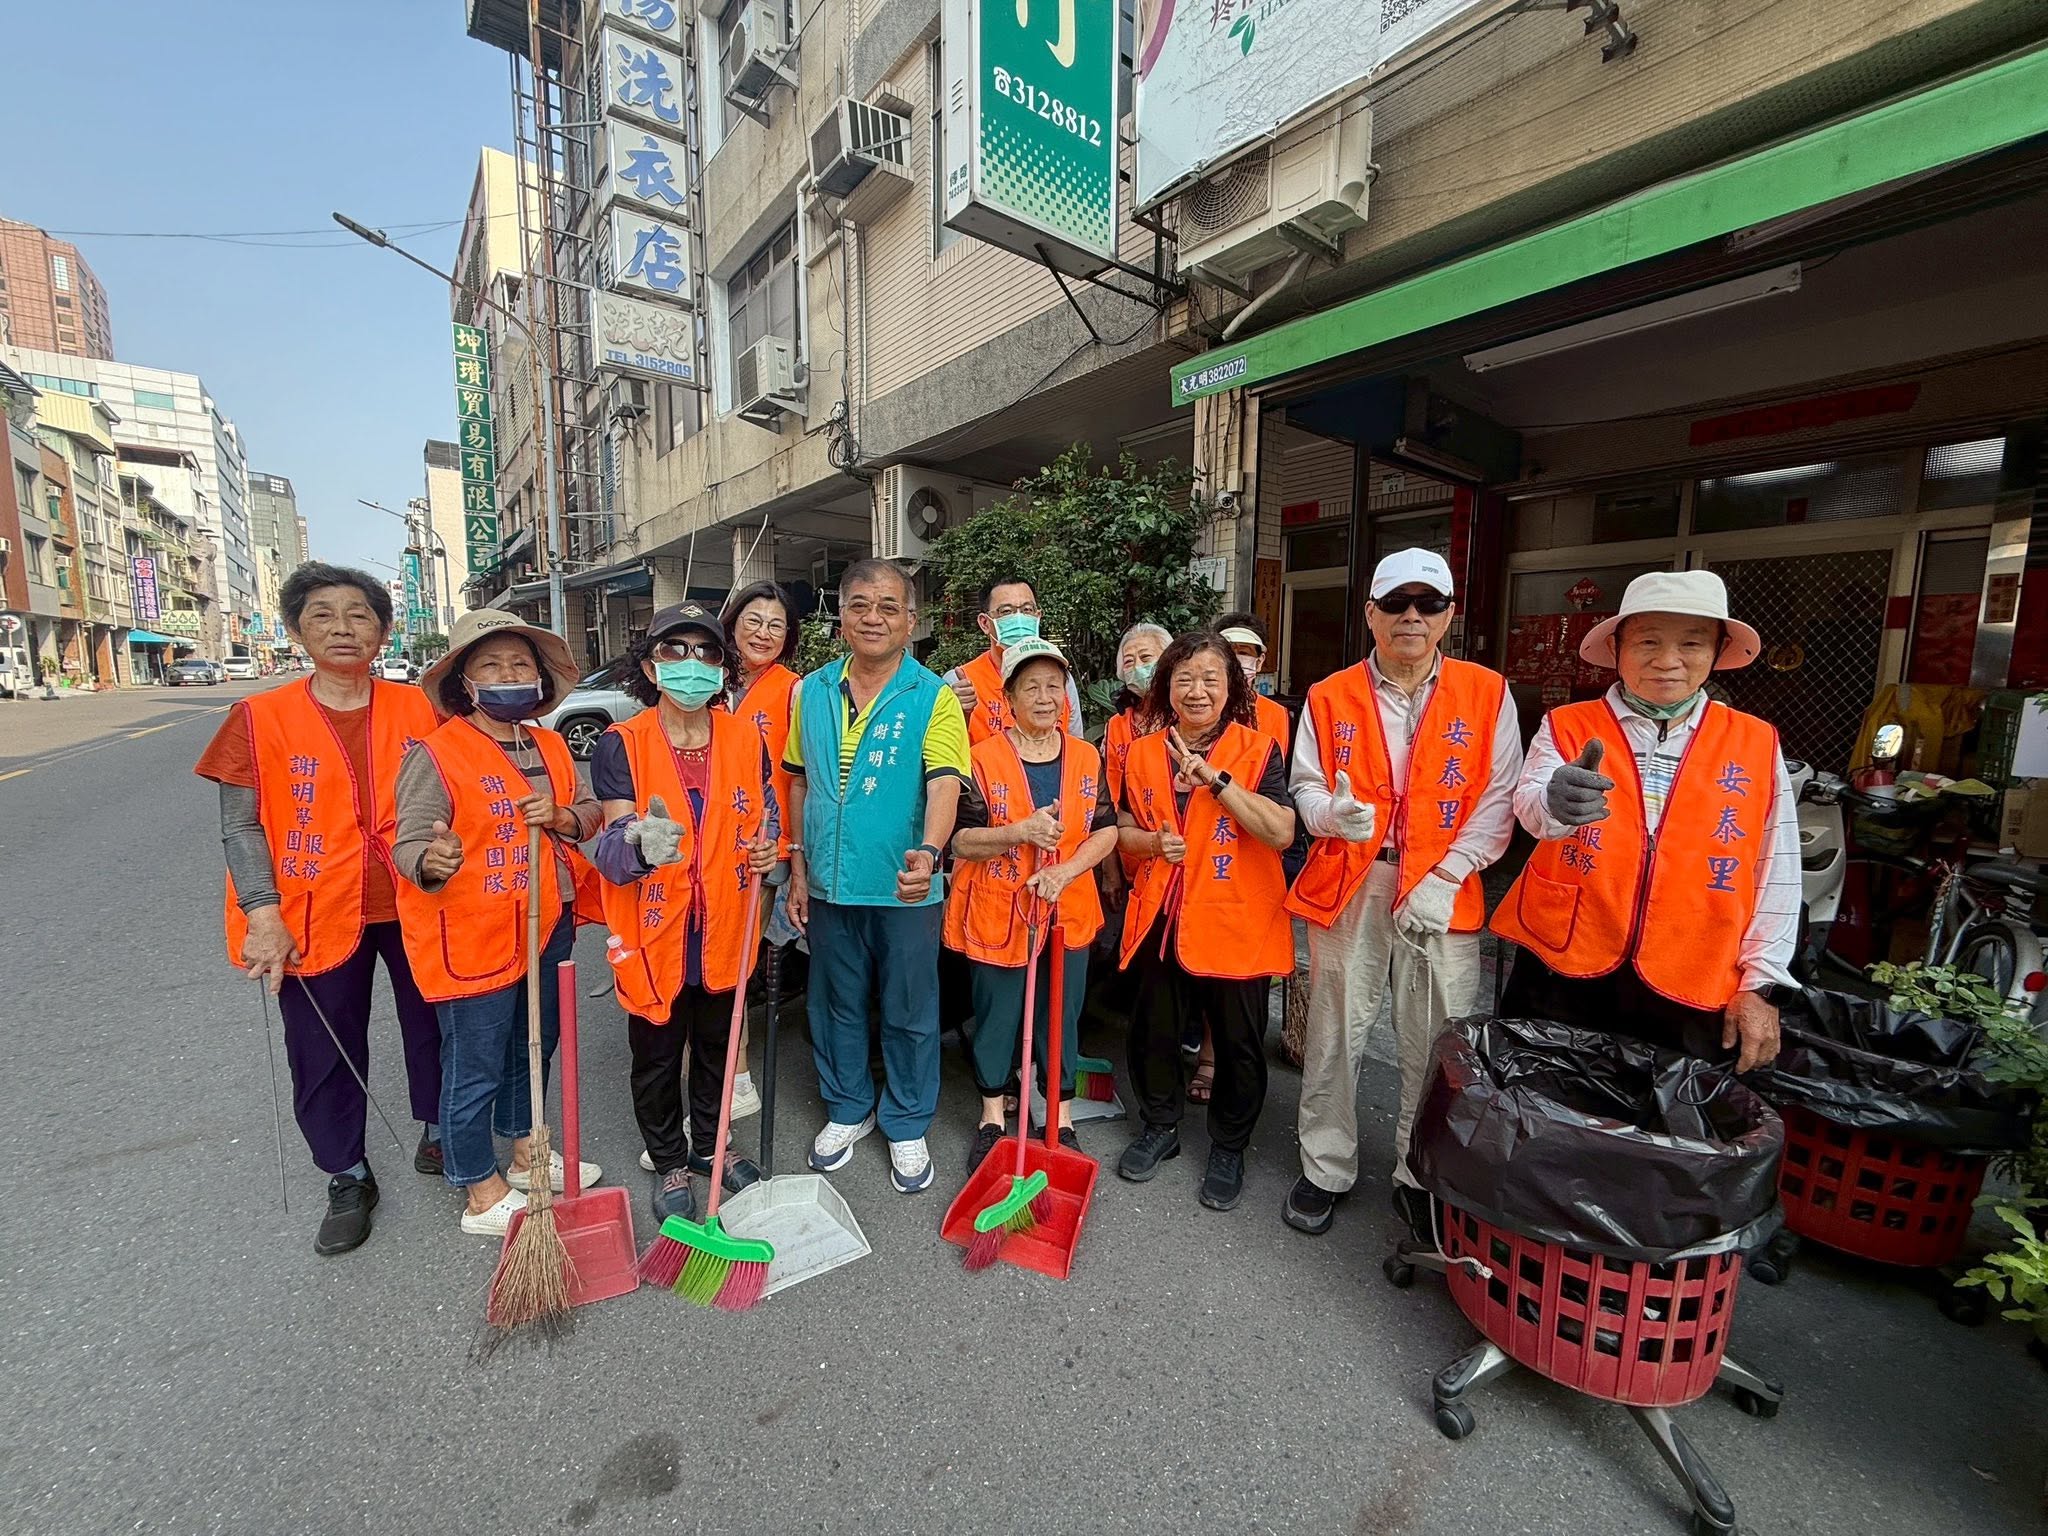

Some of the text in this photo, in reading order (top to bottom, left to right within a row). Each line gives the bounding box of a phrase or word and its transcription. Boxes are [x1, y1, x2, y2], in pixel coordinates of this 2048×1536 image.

[1012, 76, 1102, 147] 3128812
[300, 534, 308, 562] MIDTOW
[892, 712, 906, 739] 安泰里
[988, 701, 1003, 737] 謝明
[862, 723, 889, 795] 謝明學
[887, 746, 898, 765] 里長
[1334, 720, 1356, 768] 謝明
[289, 755, 320, 829] 謝明學
[1437, 717, 1473, 828] 安泰里
[480, 775, 518, 843] 謝明學
[1706, 761, 1751, 891] 安泰里
[281, 830, 302, 877] 團隊
[301, 833, 326, 880] 服務
[732, 786, 749, 891] 安泰里
[1211, 815, 1238, 880] 泰里
[484, 847, 507, 893] 團隊
[644, 882, 666, 928] 服務
